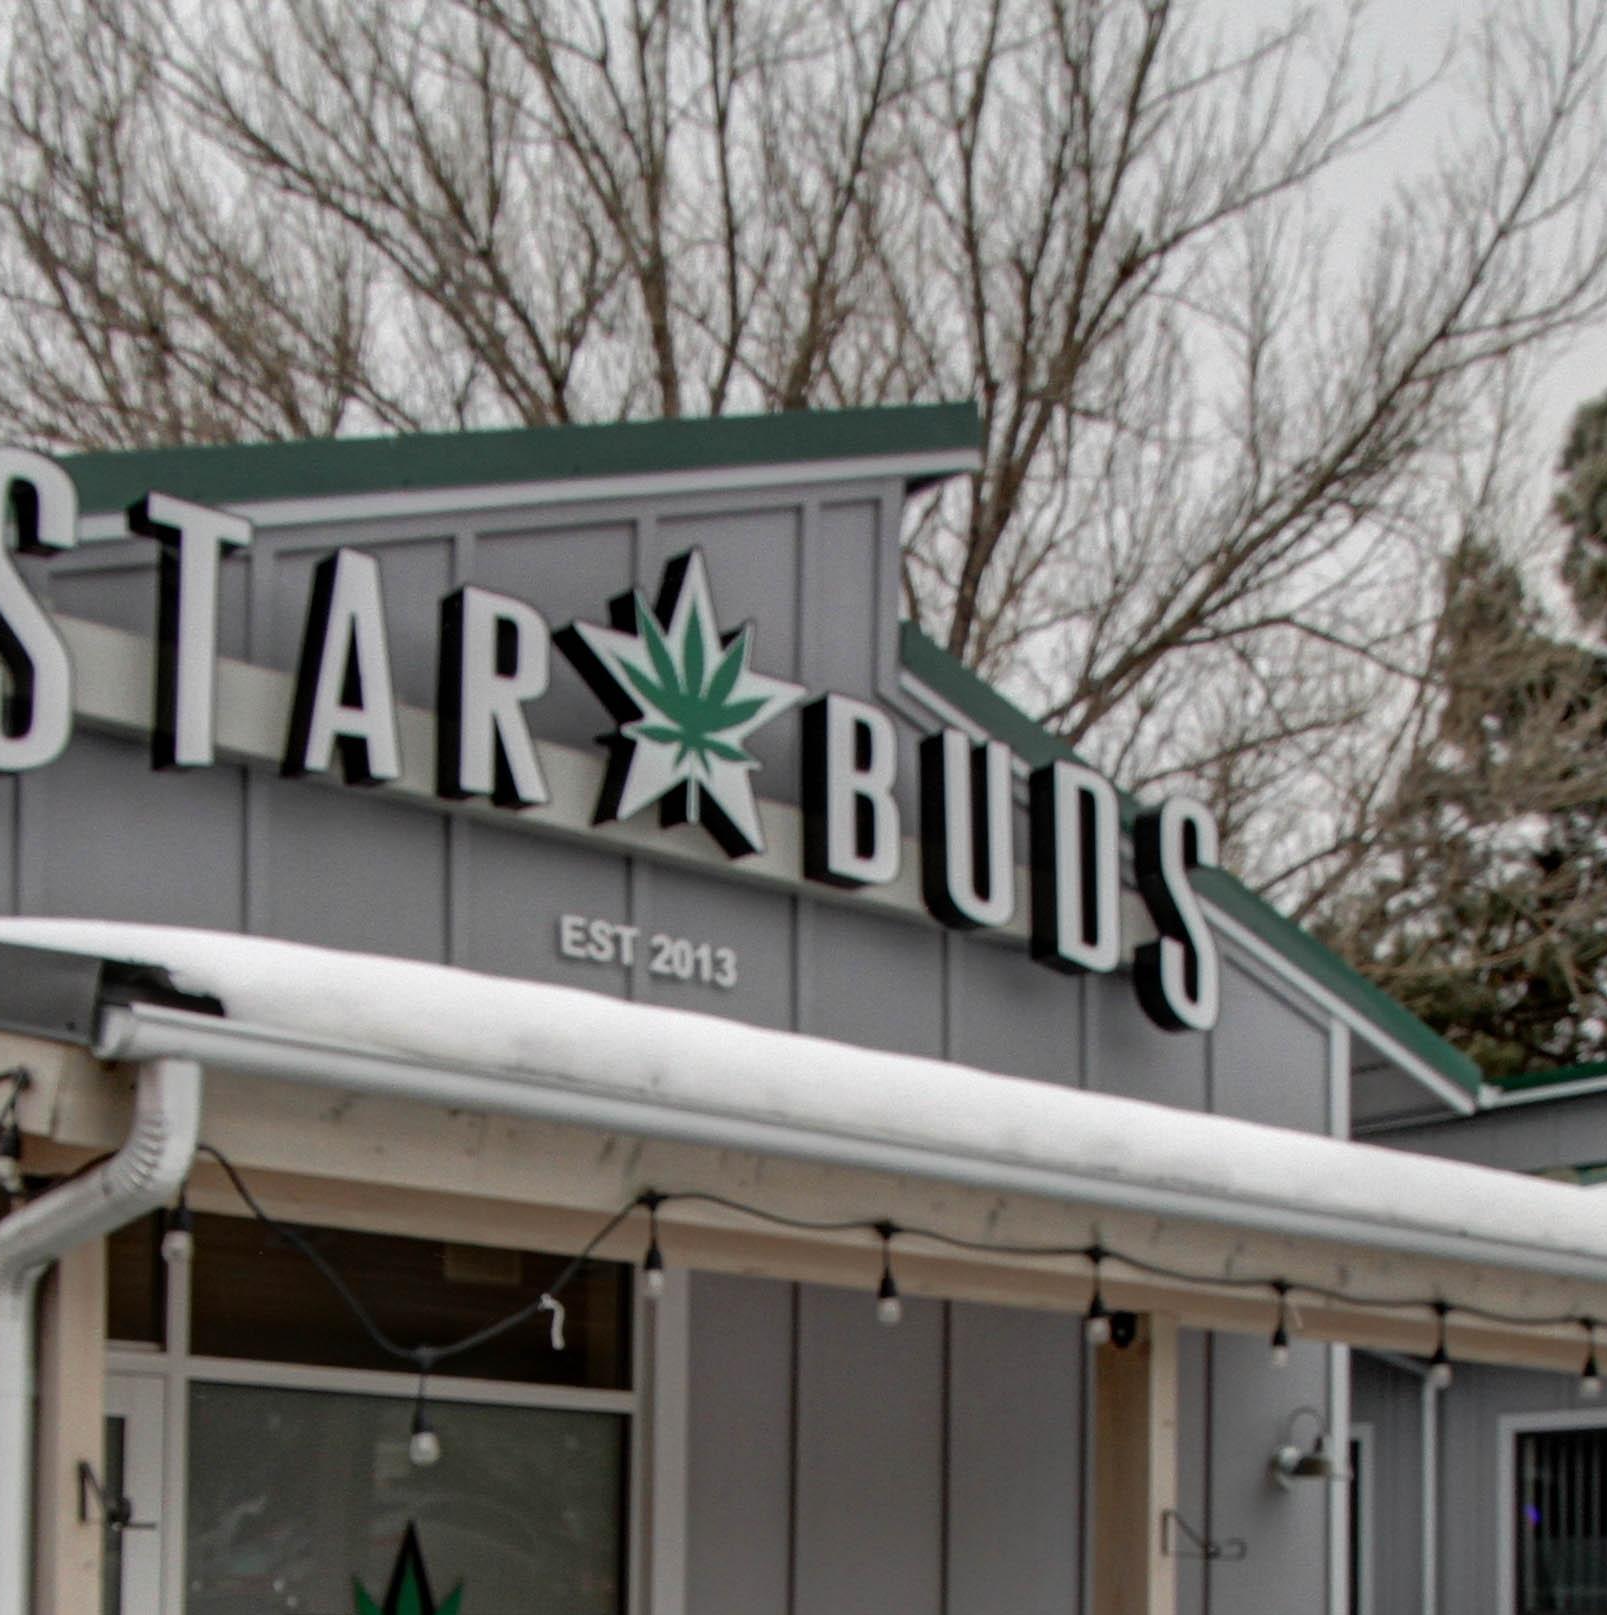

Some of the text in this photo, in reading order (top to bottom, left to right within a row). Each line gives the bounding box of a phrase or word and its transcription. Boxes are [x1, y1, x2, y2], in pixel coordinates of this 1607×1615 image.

[560, 914, 738, 988] EST 2013
[802, 693, 1220, 1033] BUDS
